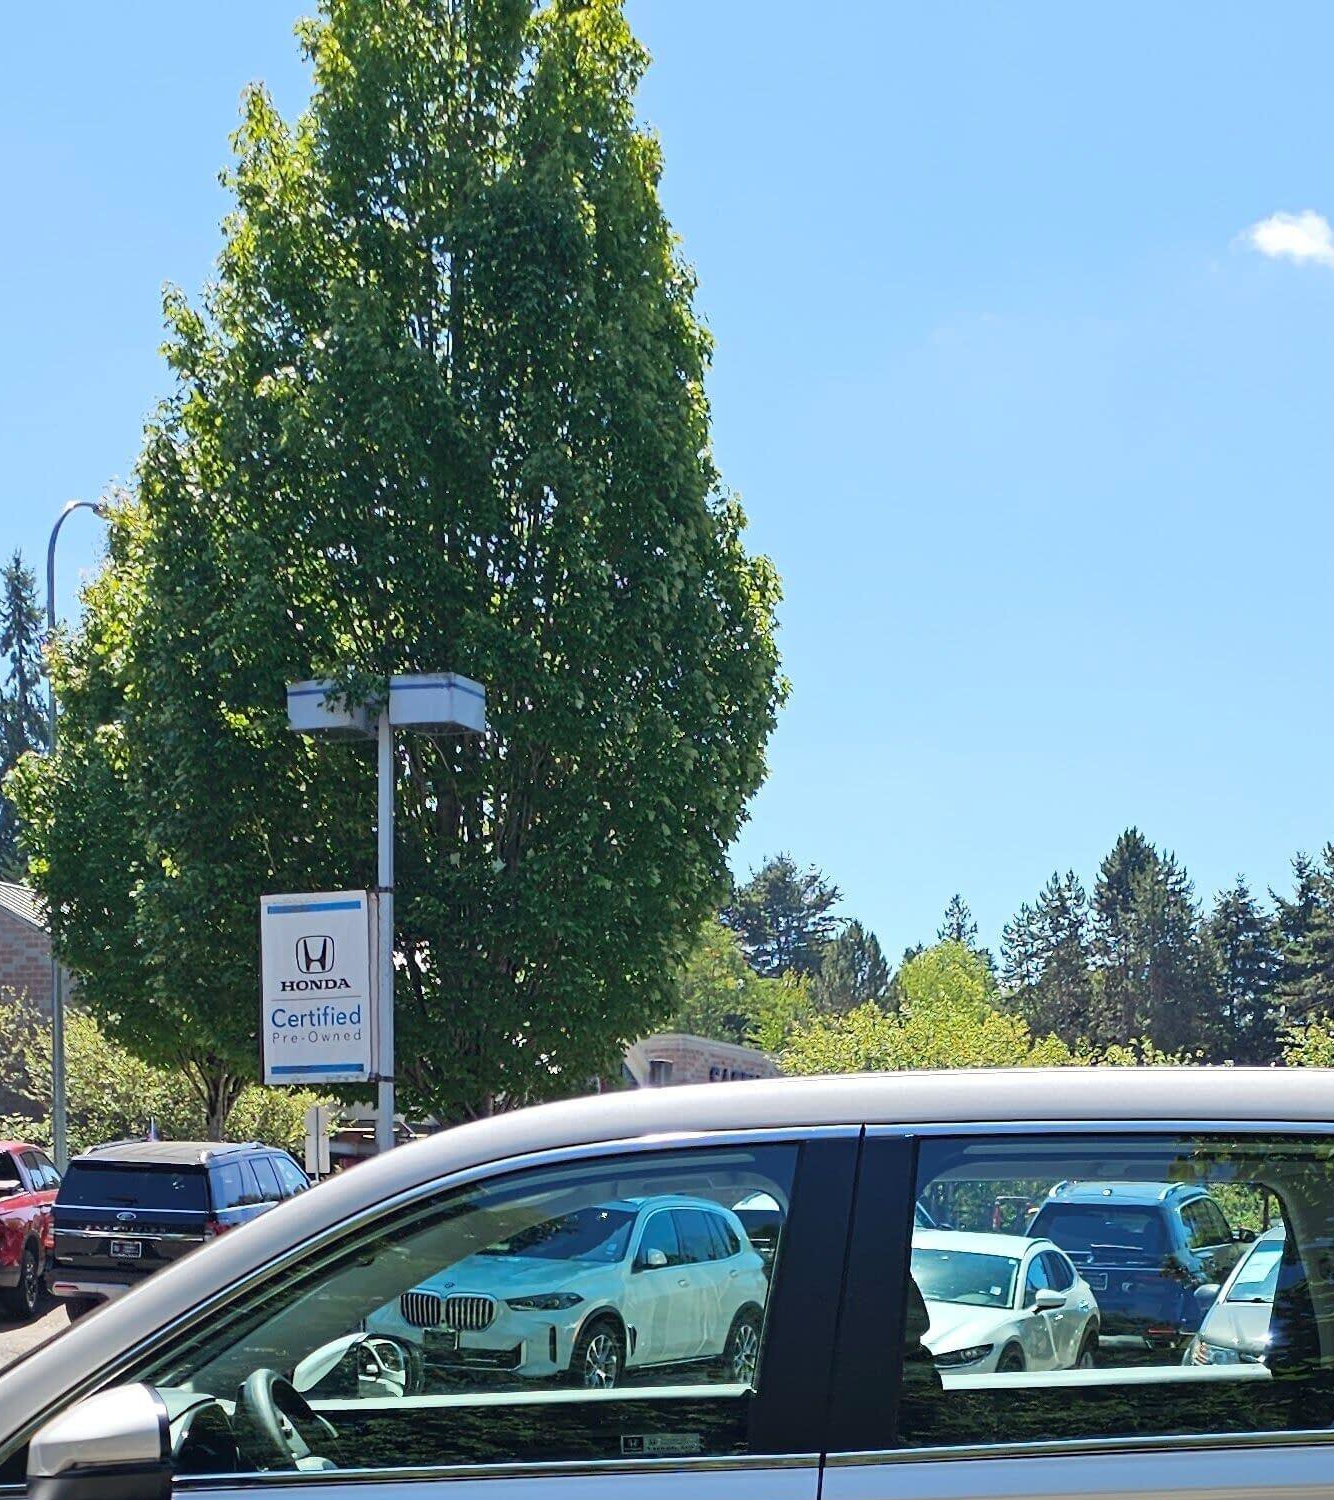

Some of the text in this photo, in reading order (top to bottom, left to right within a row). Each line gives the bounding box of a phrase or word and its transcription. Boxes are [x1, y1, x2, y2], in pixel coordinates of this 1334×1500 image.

[280, 978, 352, 992] HONDA
[271, 1003, 362, 1028] Certified
[272, 1029, 362, 1044] Pre-Owned
